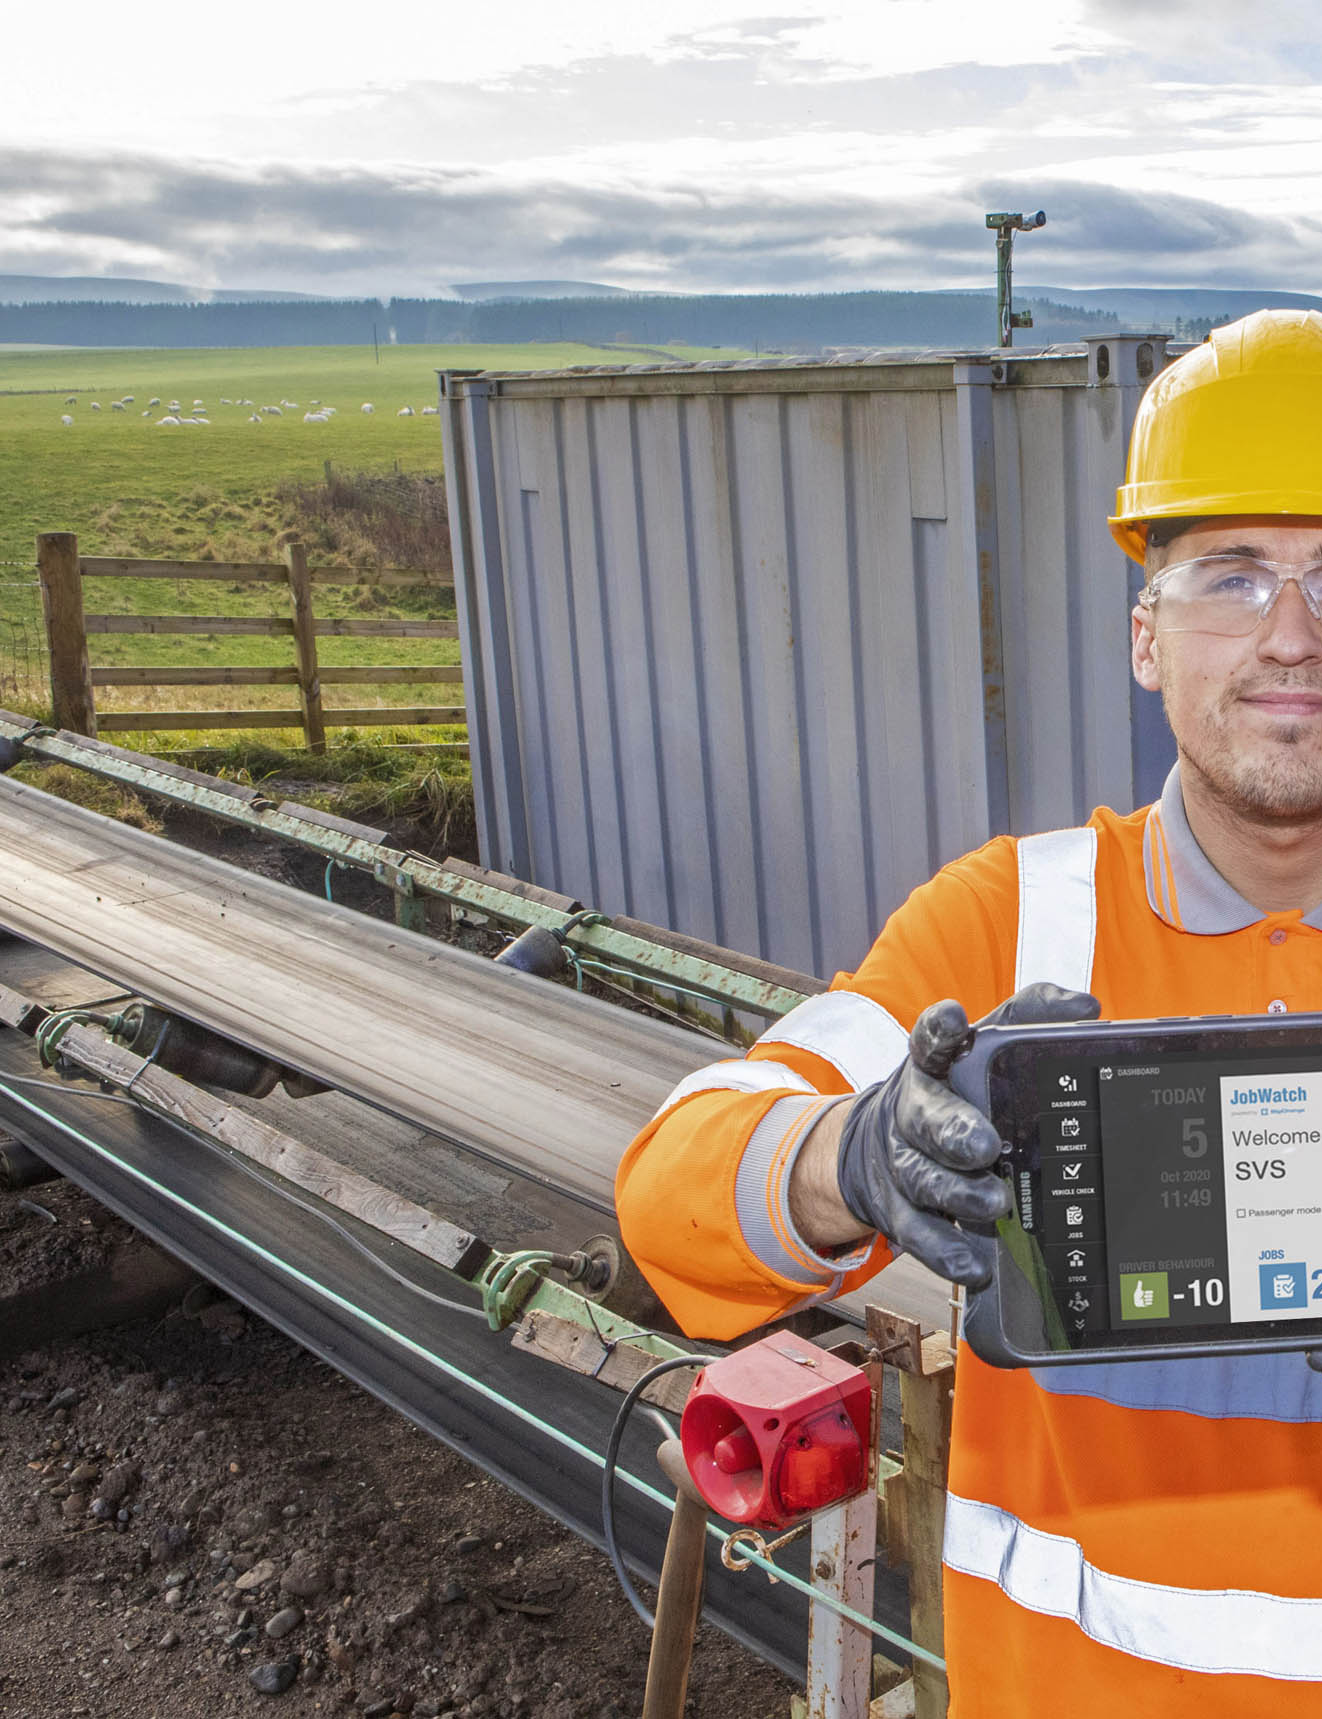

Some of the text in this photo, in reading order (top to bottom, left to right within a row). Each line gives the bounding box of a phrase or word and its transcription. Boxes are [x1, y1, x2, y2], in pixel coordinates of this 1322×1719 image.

[1117, 1067, 1161, 1077] DASHBOARD
[1152, 1087, 1207, 1105] TODAY
[1230, 1086, 1307, 1105] JobWatch
[1051, 1100, 1087, 1108] DASHBOARD
[1182, 1117, 1208, 1159] 5
[1232, 1129, 1321, 1147] Welcome
[1055, 1144, 1087, 1152] TIMESHEET
[1160, 1169, 1211, 1184] Oct 2020
[1235, 1159, 1286, 1181] SVS
[1051, 1187, 1096, 1196] VEHICLE CHECK
[1161, 1188, 1212, 1209] 11:49
[1020, 1171, 1033, 1230] SAMSUNG
[1248, 1206, 1322, 1218] Passenger mode
[1258, 1249, 1285, 1260] JOBS
[1119, 1257, 1216, 1273] DRIVER BEHAVIOUR
[1068, 1275, 1087, 1283] STOCK
[1173, 1278, 1224, 1307] -10
